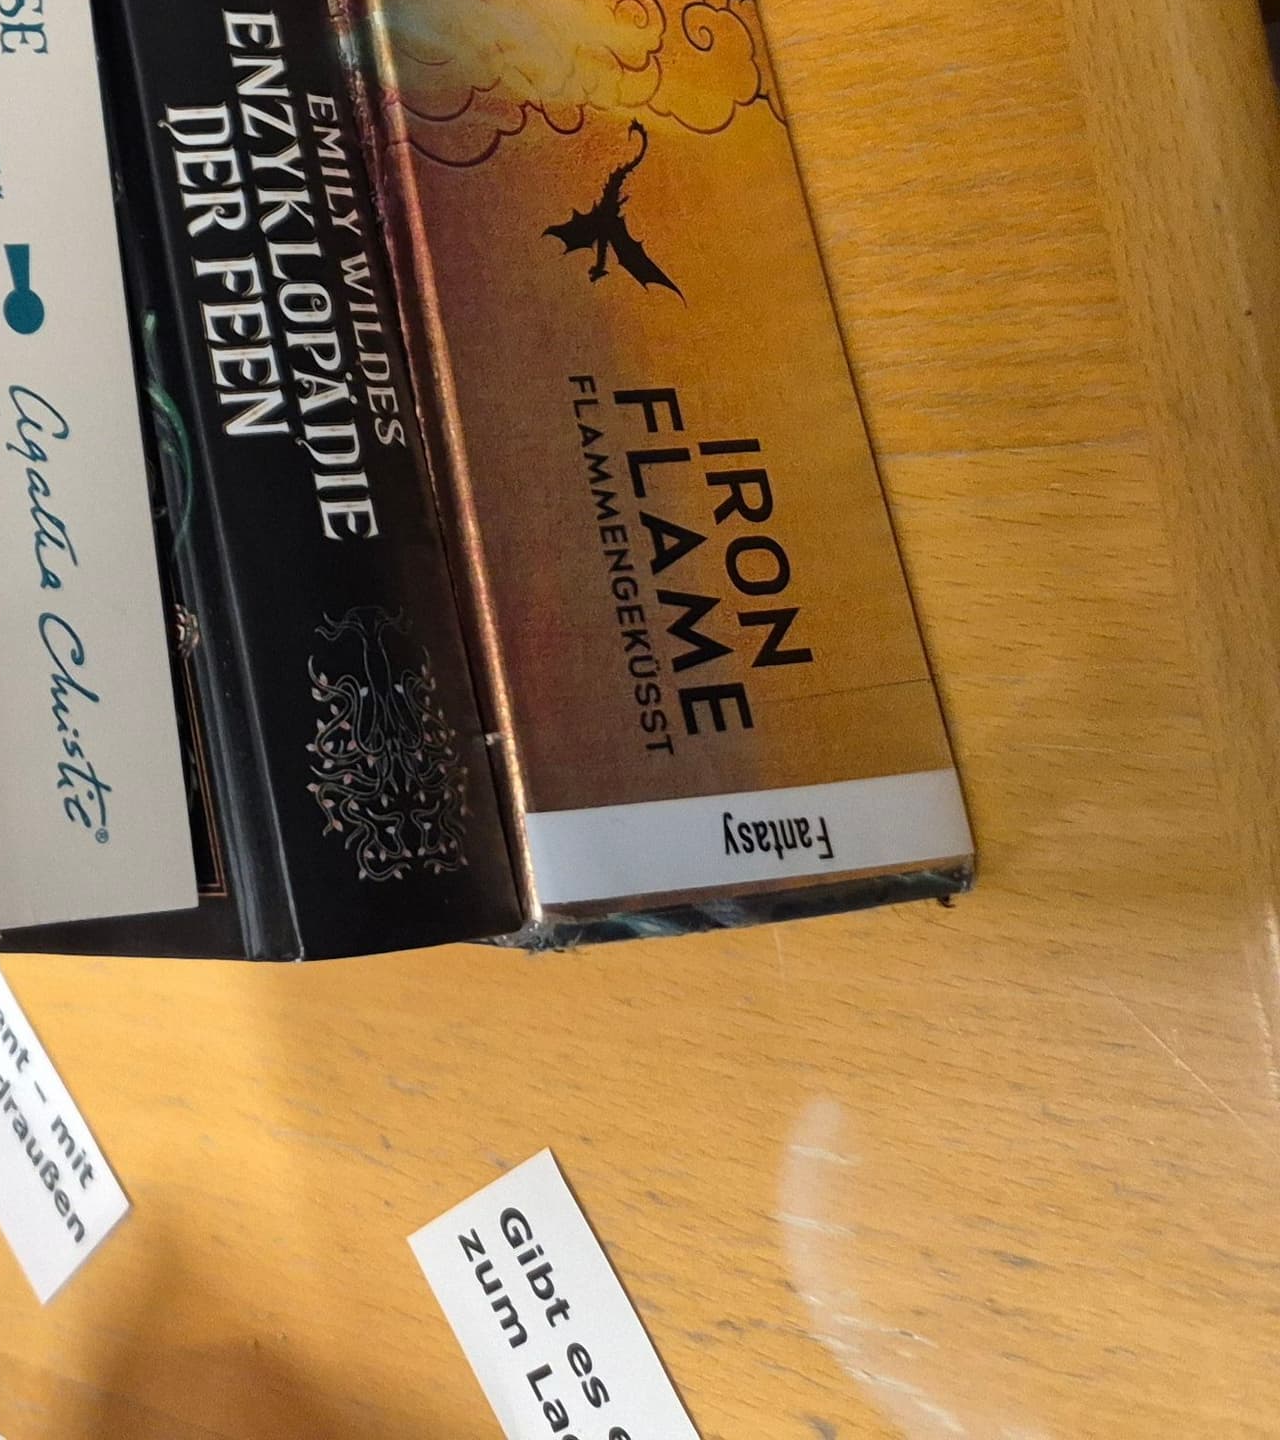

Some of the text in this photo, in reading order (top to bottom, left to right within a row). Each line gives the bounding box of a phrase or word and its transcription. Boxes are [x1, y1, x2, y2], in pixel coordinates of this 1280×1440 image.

[156, 103, 291, 441] DER FEEN
[221, 9, 380, 544] ENZYKLOPÄDIE
[306, 90, 407, 450] EMILY WILDES
[6, 382, 83, 593] Agatha
[566, 373, 675, 756] FLAMMENGEKÜSST
[612, 386, 756, 738] FLAME
[697, 437, 815, 669] IRON
[722, 811, 834, 860] Fantasy
[49, 1114, 95, 1190] mit
[457, 1227, 529, 1350] zum
[498, 1206, 611, 1410] Gibt es
